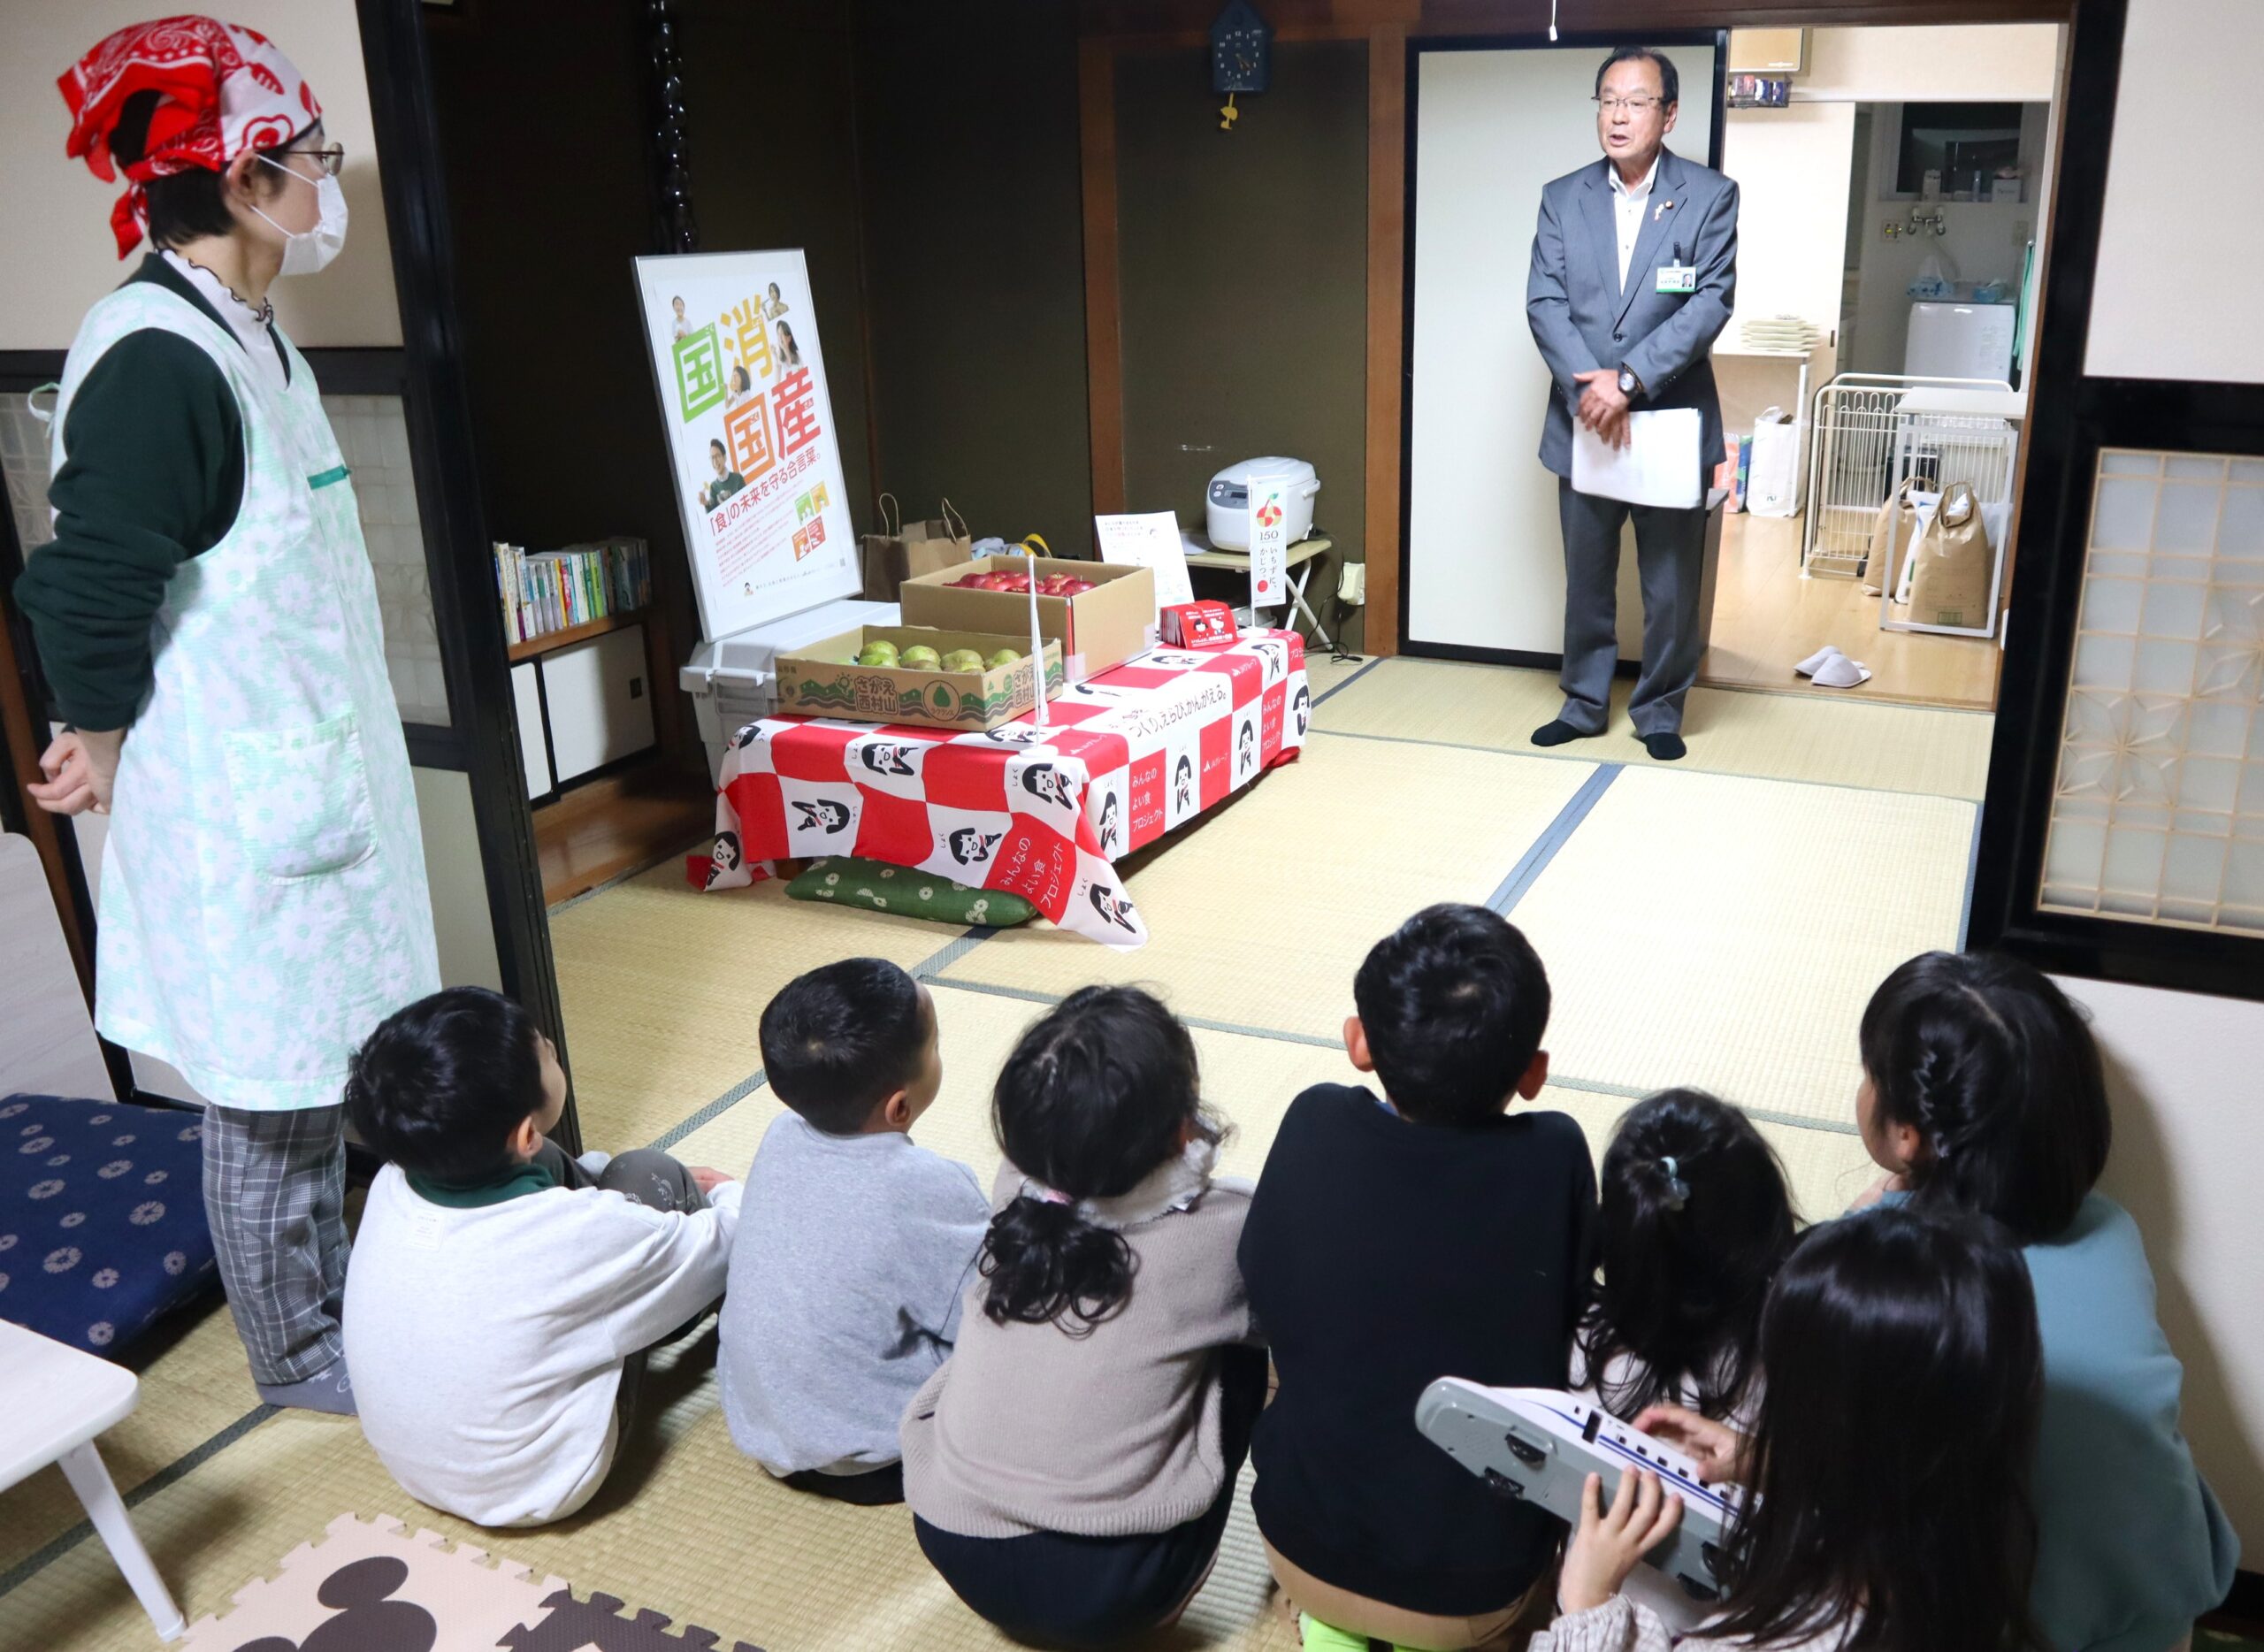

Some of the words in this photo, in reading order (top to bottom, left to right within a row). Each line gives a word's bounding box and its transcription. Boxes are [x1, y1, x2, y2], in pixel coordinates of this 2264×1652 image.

[723, 365, 822, 485] 国産
[709, 446, 821, 537] 「食」の未来を守る合言葉。
[1259, 530, 1279, 541] 150
[856, 677, 894, 696] さがえ
[858, 695, 896, 712] 西村山
[1128, 684, 1227, 738] つくり、えらび、かんがえる。
[1132, 768, 1158, 787] みんなの
[1132, 792, 1151, 811] よい食
[1132, 809, 1164, 832] プロジェクト
[1000, 837, 1031, 885] みんなの
[1040, 842, 1063, 909] プロジェクト
[1021, 859, 1046, 895] よい食
